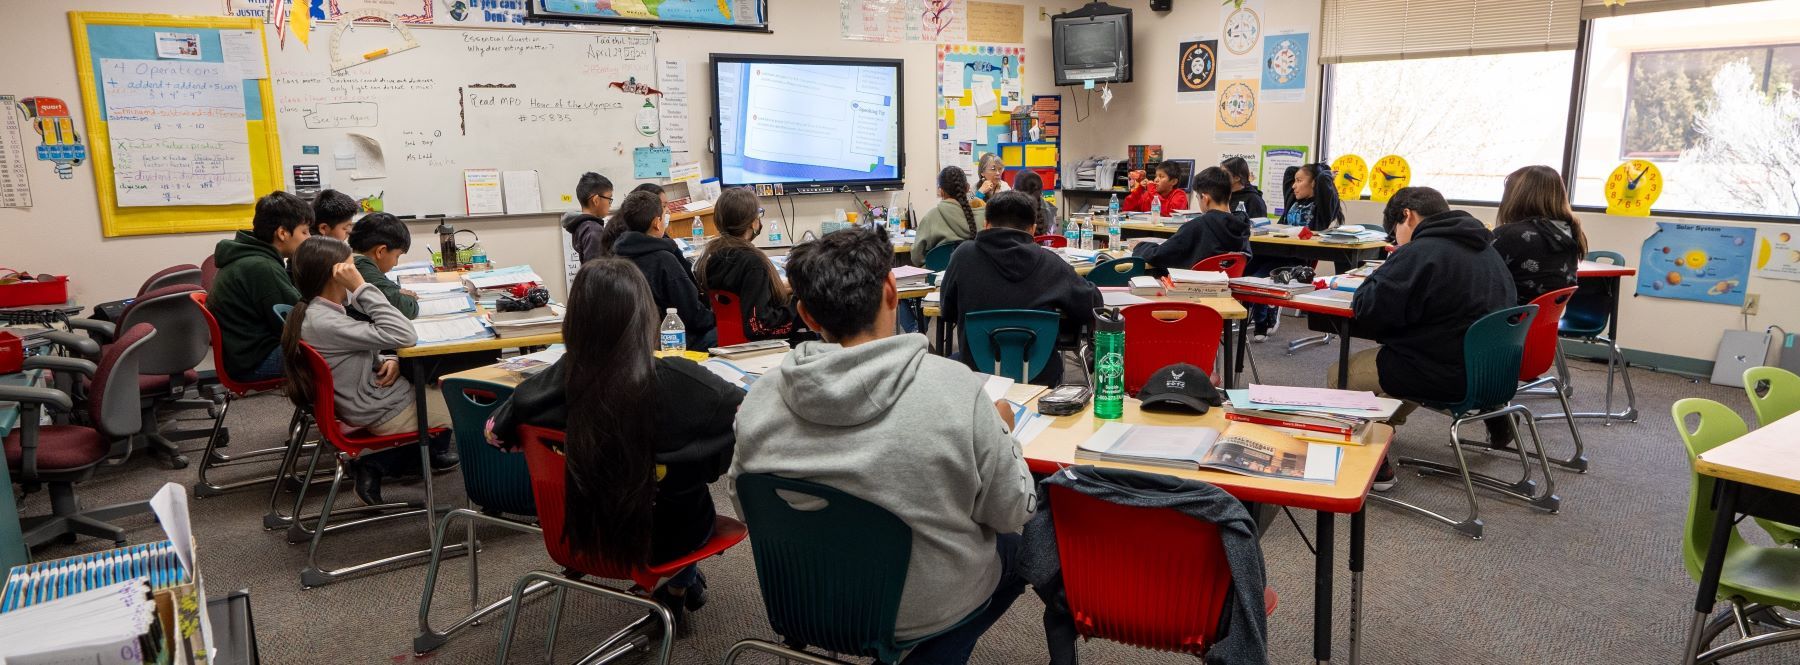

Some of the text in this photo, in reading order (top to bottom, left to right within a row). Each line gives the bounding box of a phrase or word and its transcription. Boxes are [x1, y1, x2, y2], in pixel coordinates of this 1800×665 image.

[462, 32, 503, 42] Essential
[468, 45, 484, 56] Why
[587, 44, 611, 60] April
[114, 63, 219, 78] 4 Operations
[127, 80, 163, 89] addend
[174, 81, 206, 89] addend
[330, 85, 348, 95] only
[470, 94, 494, 107] Read
[568, 100, 581, 108] the
